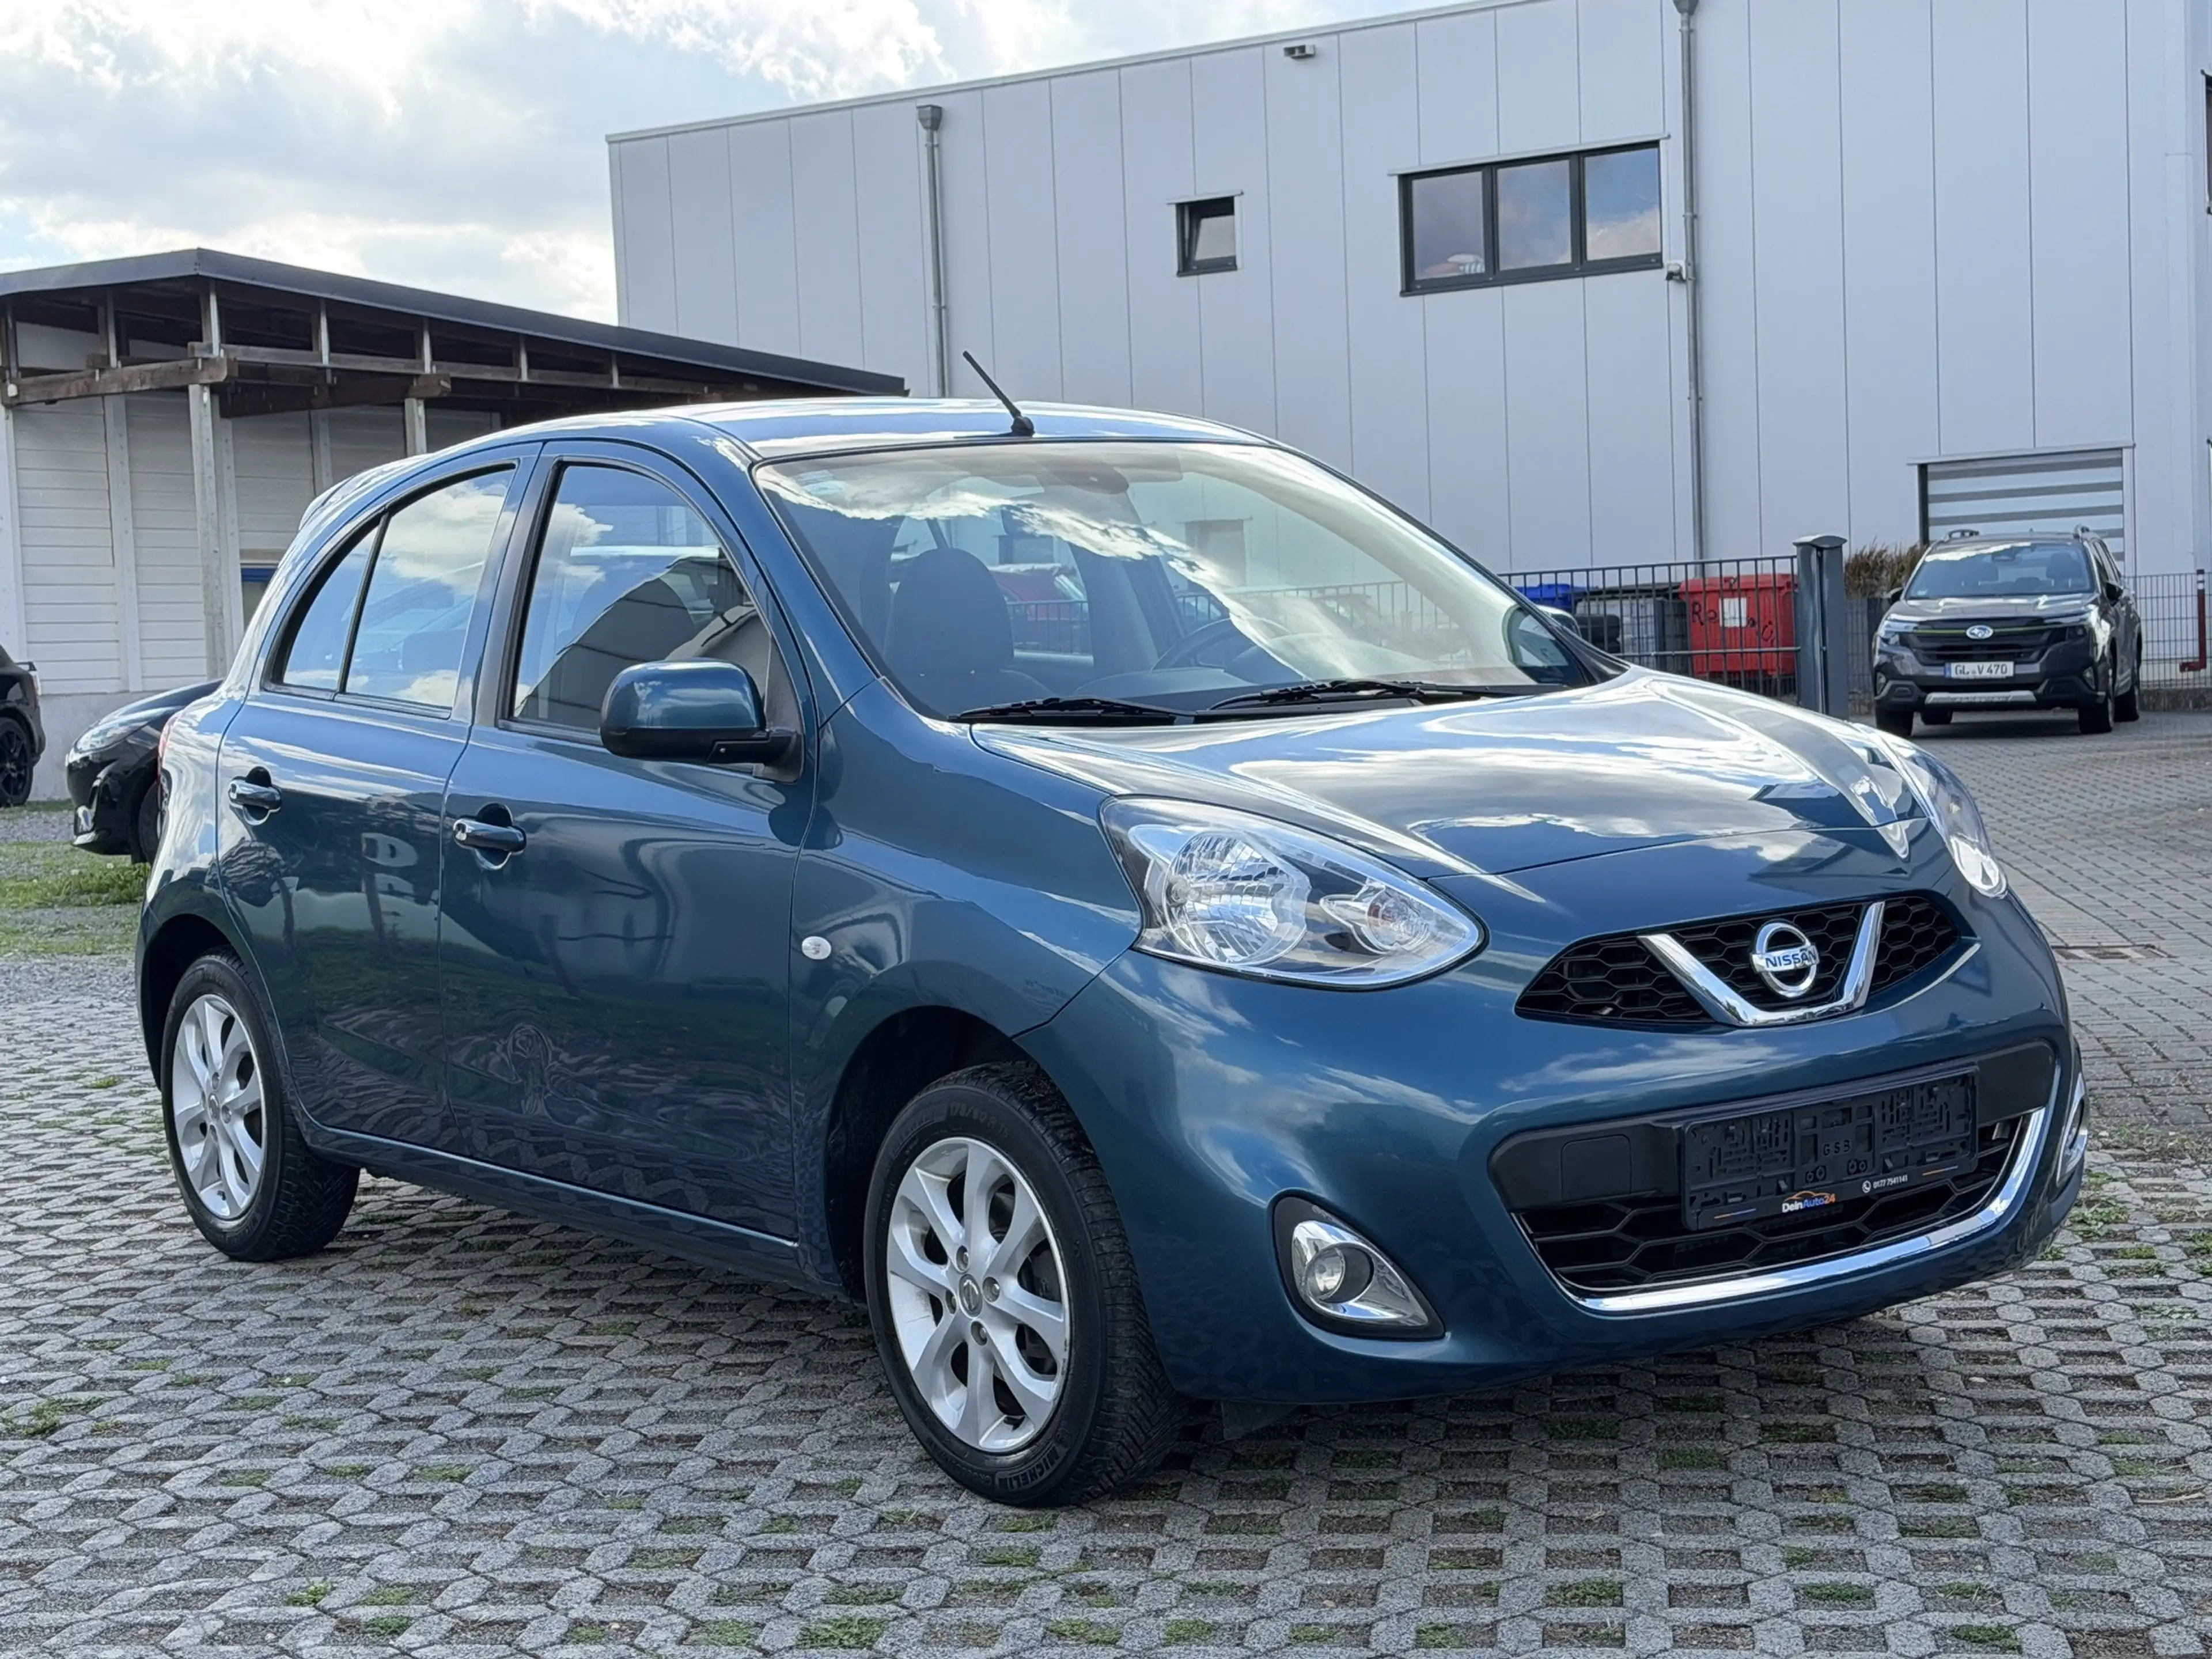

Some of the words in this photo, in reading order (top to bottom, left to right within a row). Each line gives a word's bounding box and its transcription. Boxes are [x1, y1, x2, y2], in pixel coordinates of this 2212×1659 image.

[1955, 664, 1969, 675] GL
[1977, 664, 1984, 675] V
[1987, 663, 2008, 675] 470
[1764, 949, 1816, 968] NISSAN
[1782, 1193, 1836, 1213] DeinAuto24
